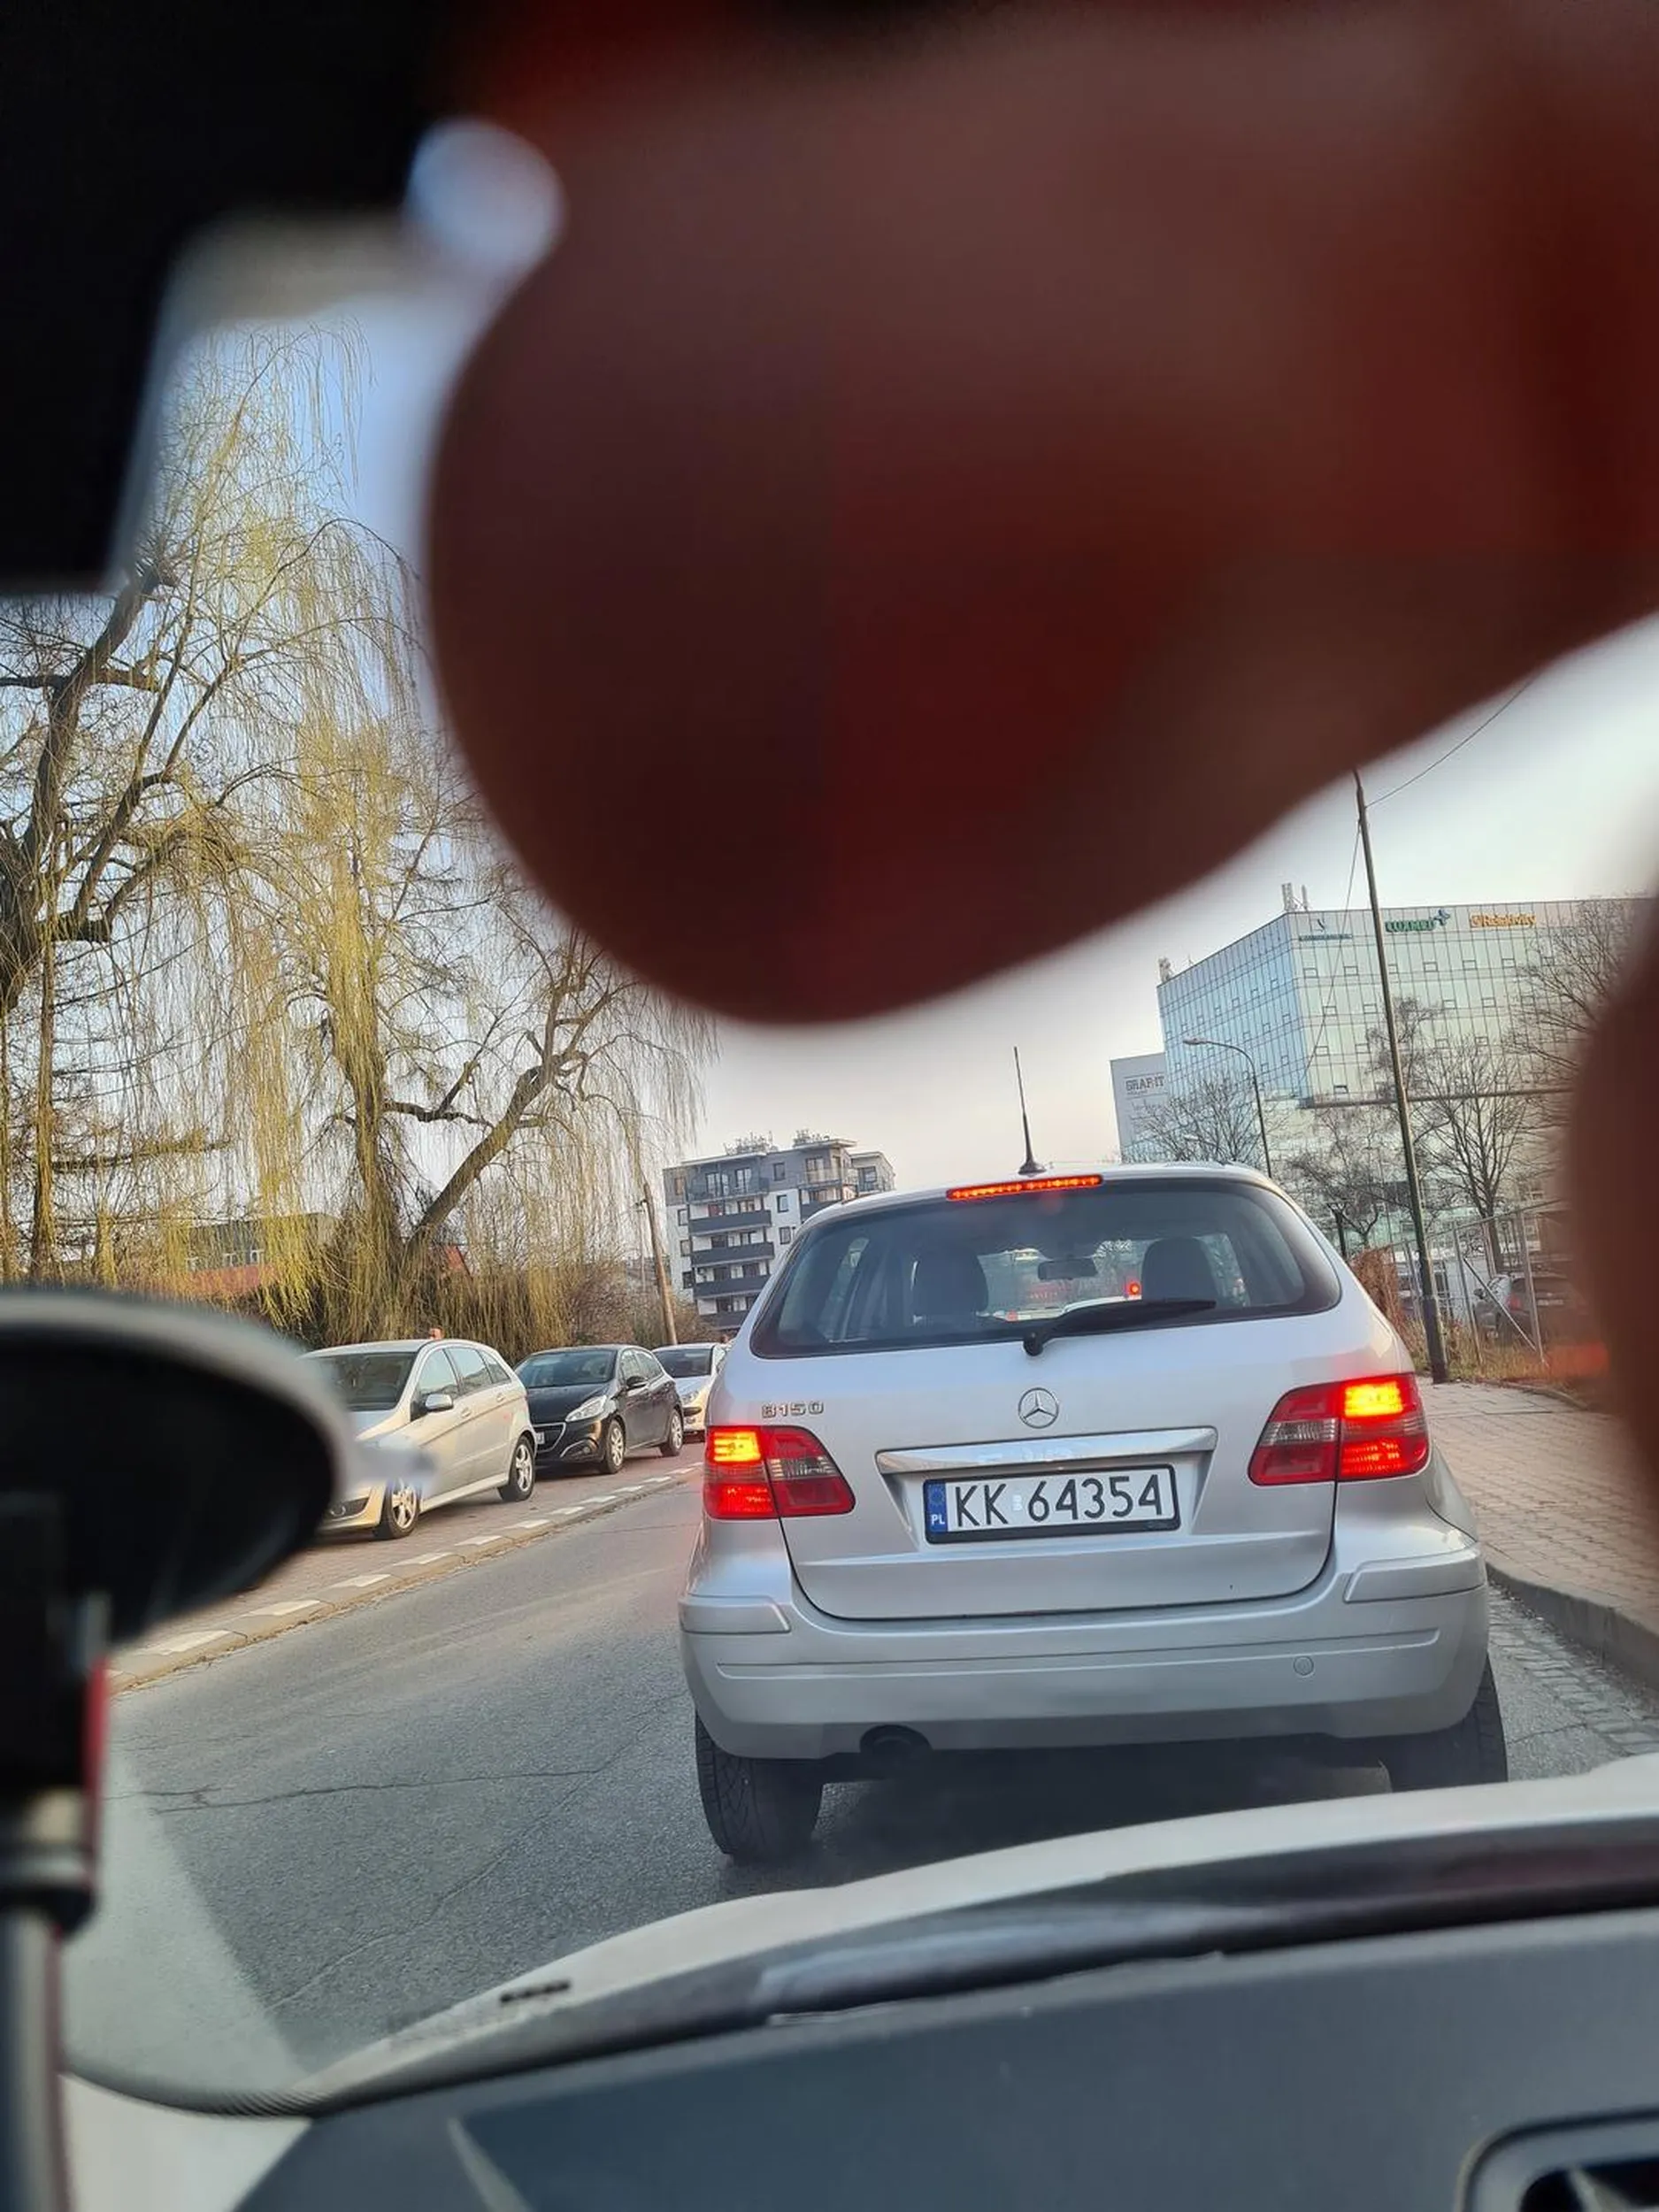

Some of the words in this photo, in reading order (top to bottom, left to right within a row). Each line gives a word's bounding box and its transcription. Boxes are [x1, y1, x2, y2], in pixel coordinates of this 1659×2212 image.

[762, 1402, 824, 1417] B150
[956, 1483, 1009, 1527] KK
[1027, 1474, 1163, 1522] 64354
[931, 1514, 945, 1525] PL
